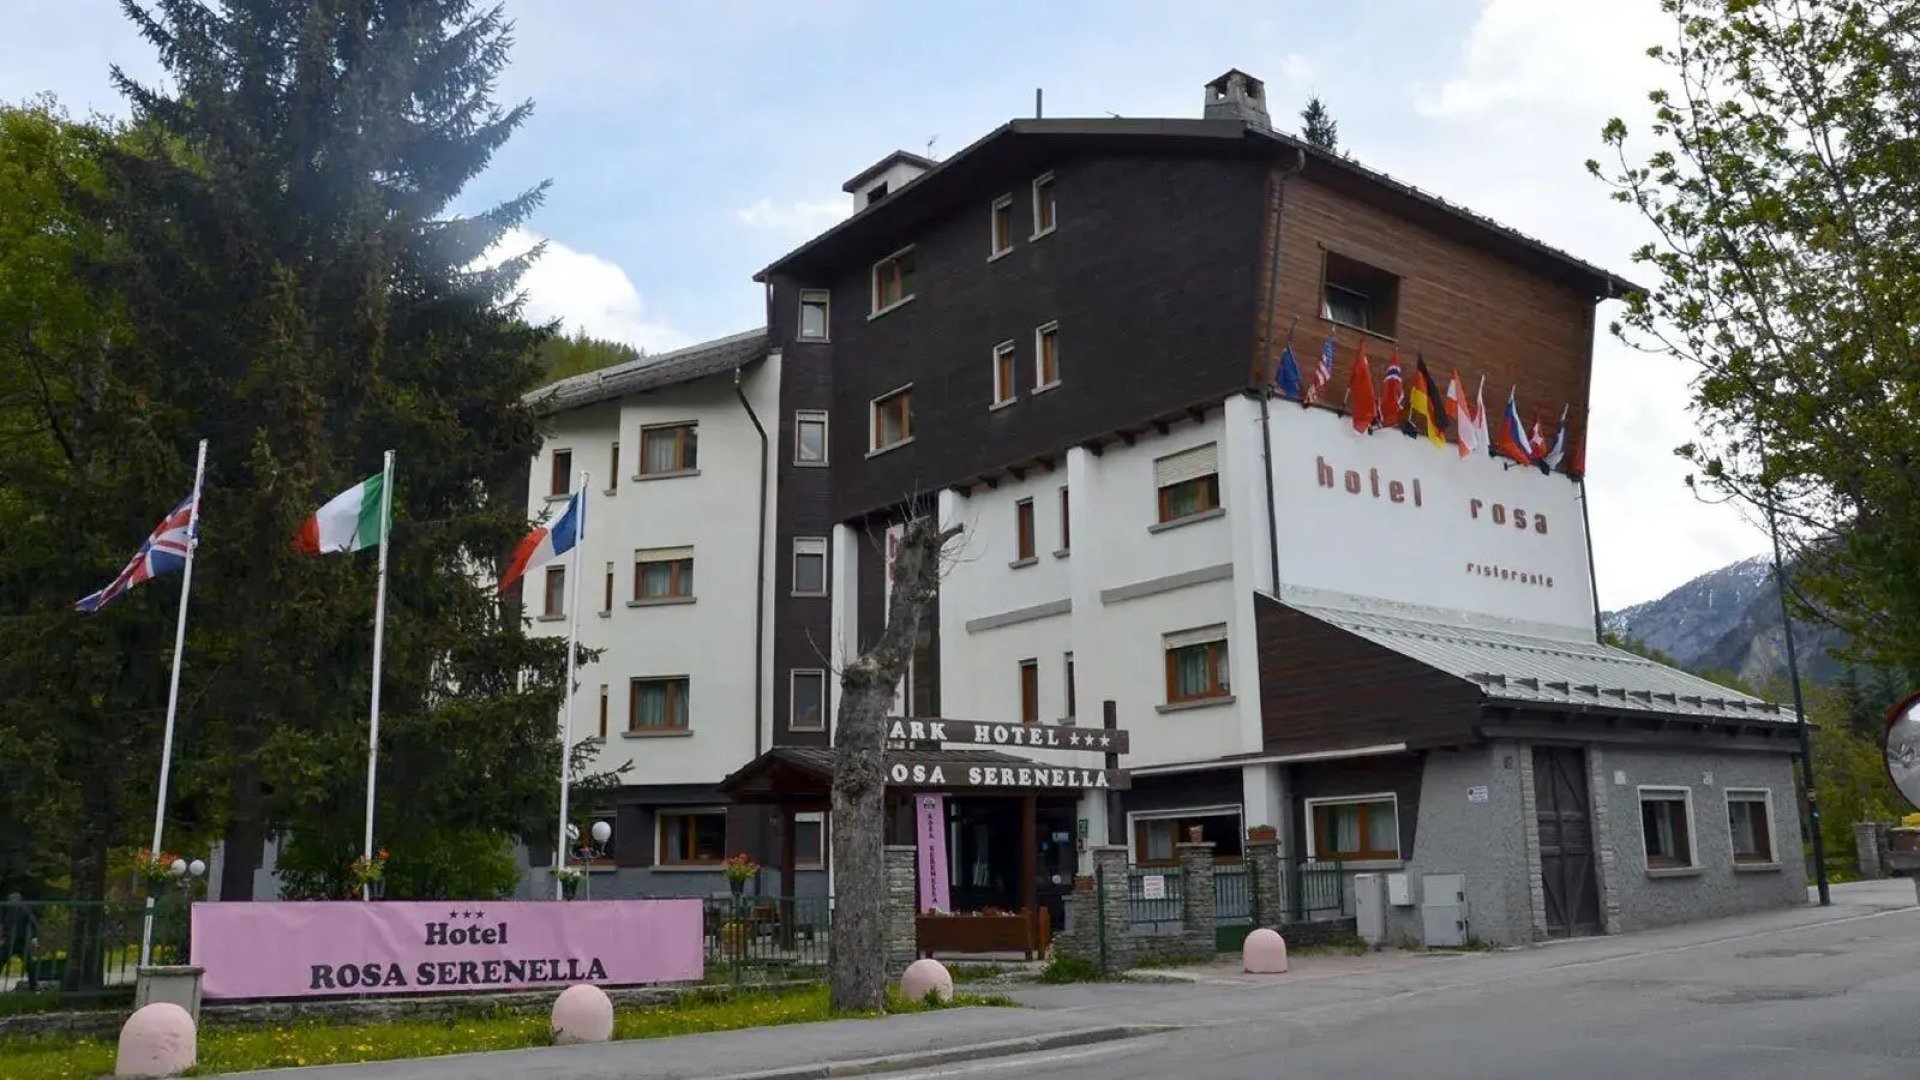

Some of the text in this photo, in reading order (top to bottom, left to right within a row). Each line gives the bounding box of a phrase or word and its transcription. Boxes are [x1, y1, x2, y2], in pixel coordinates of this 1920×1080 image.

[1316, 455, 1548, 535] hotel rosa
[1466, 562, 1554, 588] ristorante
[884, 720, 1060, 746] ARK HOTEL
[884, 763, 1110, 788] OSA SERENELLA
[425, 922, 508, 946] Hotel
[309, 958, 609, 991] ROSA SERENELLA
